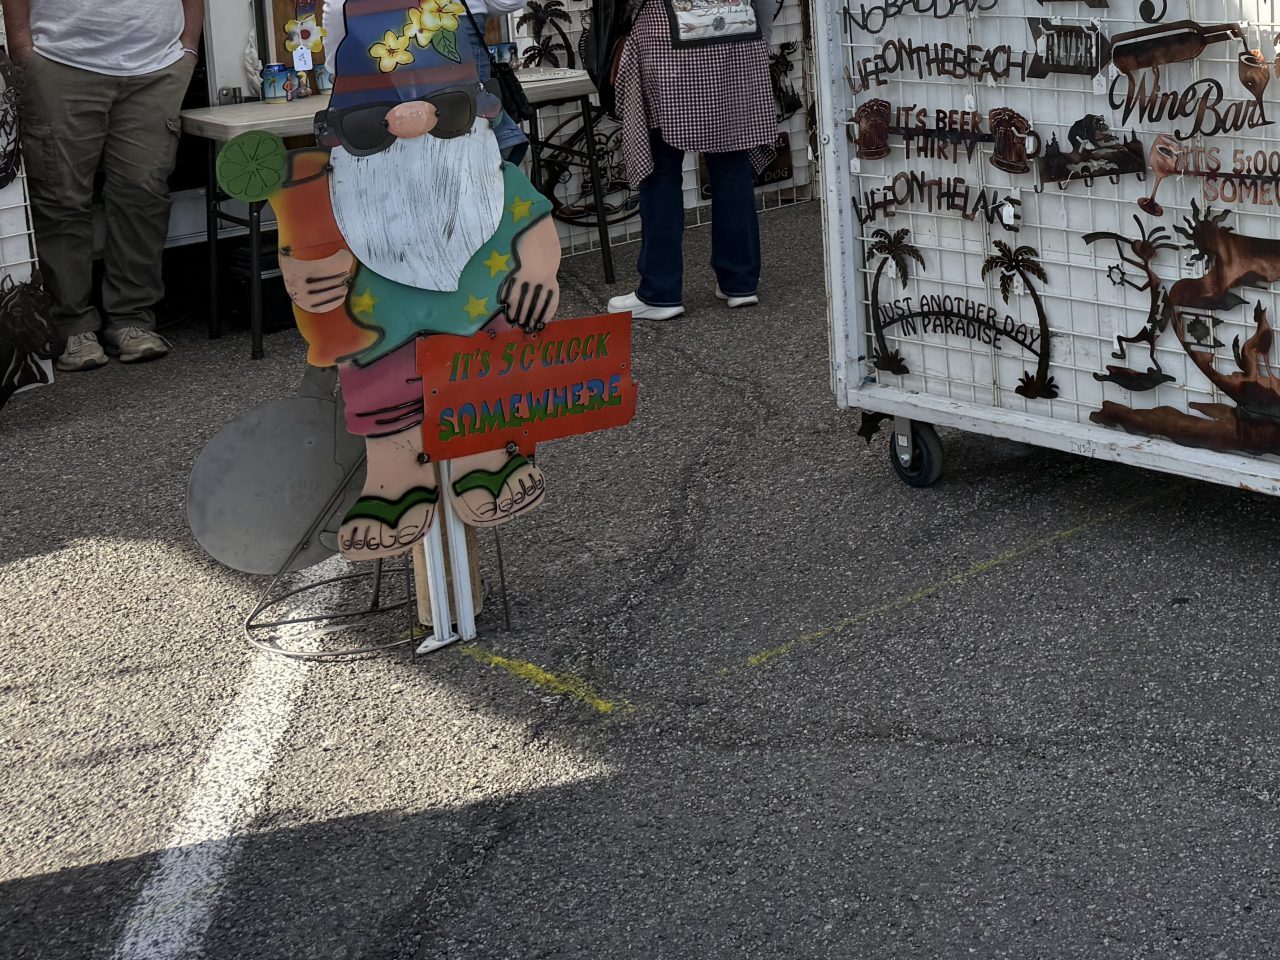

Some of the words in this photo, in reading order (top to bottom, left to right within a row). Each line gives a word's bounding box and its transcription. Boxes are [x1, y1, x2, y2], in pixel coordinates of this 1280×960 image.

[896, 103, 928, 132] IT'S
[935, 109, 984, 135] BEER
[1109, 70, 1200, 128] Wine
[1174, 78, 1262, 141] Bar
[903, 135, 978, 165] THIRTY
[764, 167, 789, 182] DOG
[878, 297, 912, 324] JUST
[920, 294, 999, 328] ANOTHER
[1001, 314, 1042, 349] DAY
[901, 316, 918, 338] IN
[921, 315, 1003, 350] PARADISE
[448, 348, 491, 383] IT'S
[498, 342, 517, 377] 5
[438, 374, 622, 441] SOMEWHERE
